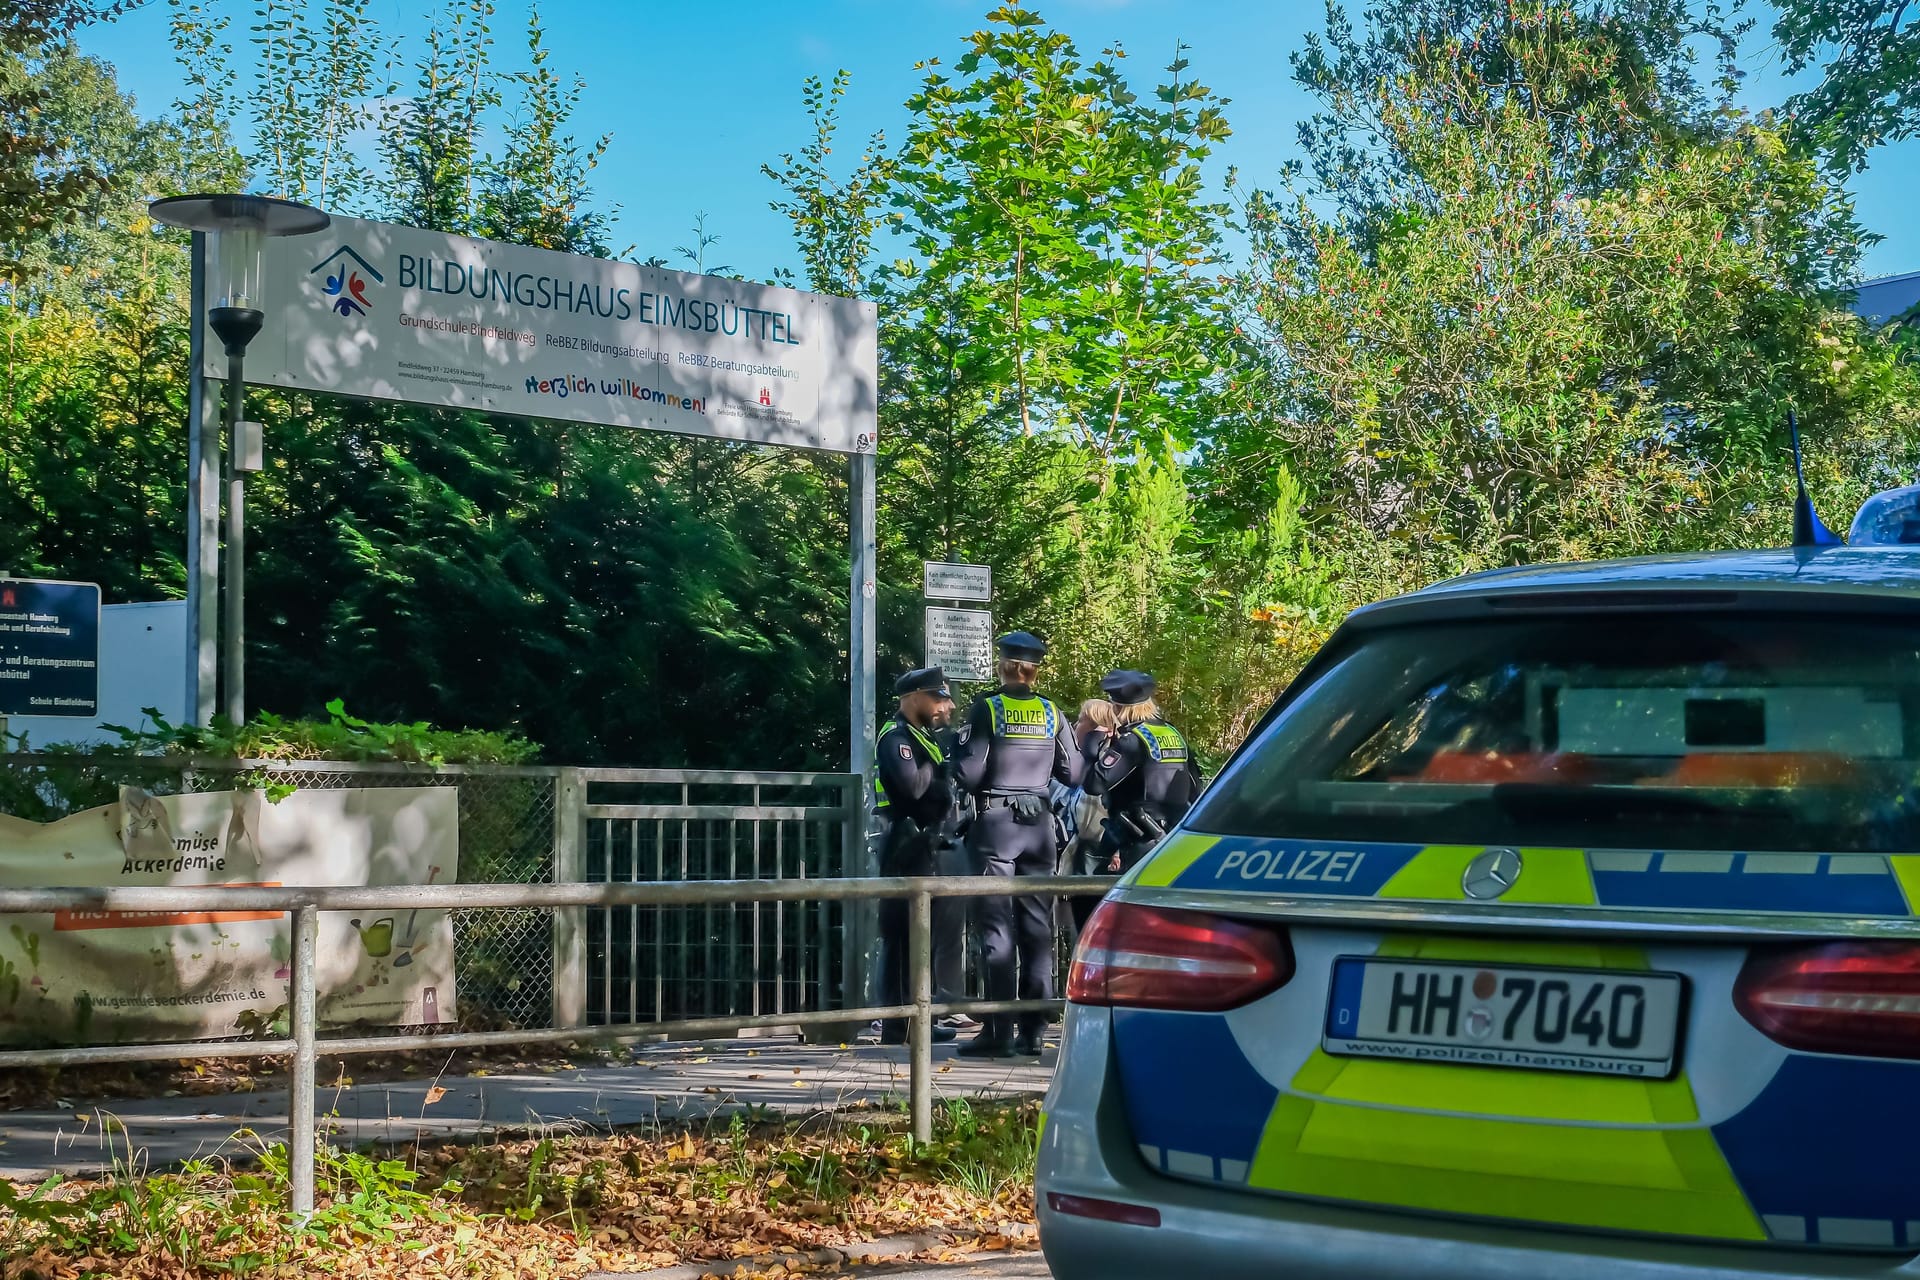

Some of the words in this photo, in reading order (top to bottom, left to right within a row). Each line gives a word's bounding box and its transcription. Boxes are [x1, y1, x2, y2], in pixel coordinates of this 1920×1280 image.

[399, 254, 631, 320] BILDUNGSHAUS
[639, 291, 800, 345] EIMSBÜTTEL
[399, 313, 468, 334] Grundschule
[470, 322, 536, 346] Bindfeldweg
[546, 333, 579, 349] ReBBZ
[580, 338, 670, 364] Bildungsabteilung
[678, 352, 709, 367] ReBBZ
[711, 356, 800, 382] Beratungsabteilung
[525, 375, 596, 398] Herzlich
[23, 655, 95, 669] Beratungszentrum
[1006, 709, 1046, 724] POLIZEI
[121, 855, 226, 874] Ackerdemie
[1215, 850, 1366, 882] POLIZEI
[1387, 972, 1463, 1037] HH
[1501, 977, 1646, 1050] 7040
[1345, 1042, 1645, 1075] www.polizei.hamburg
